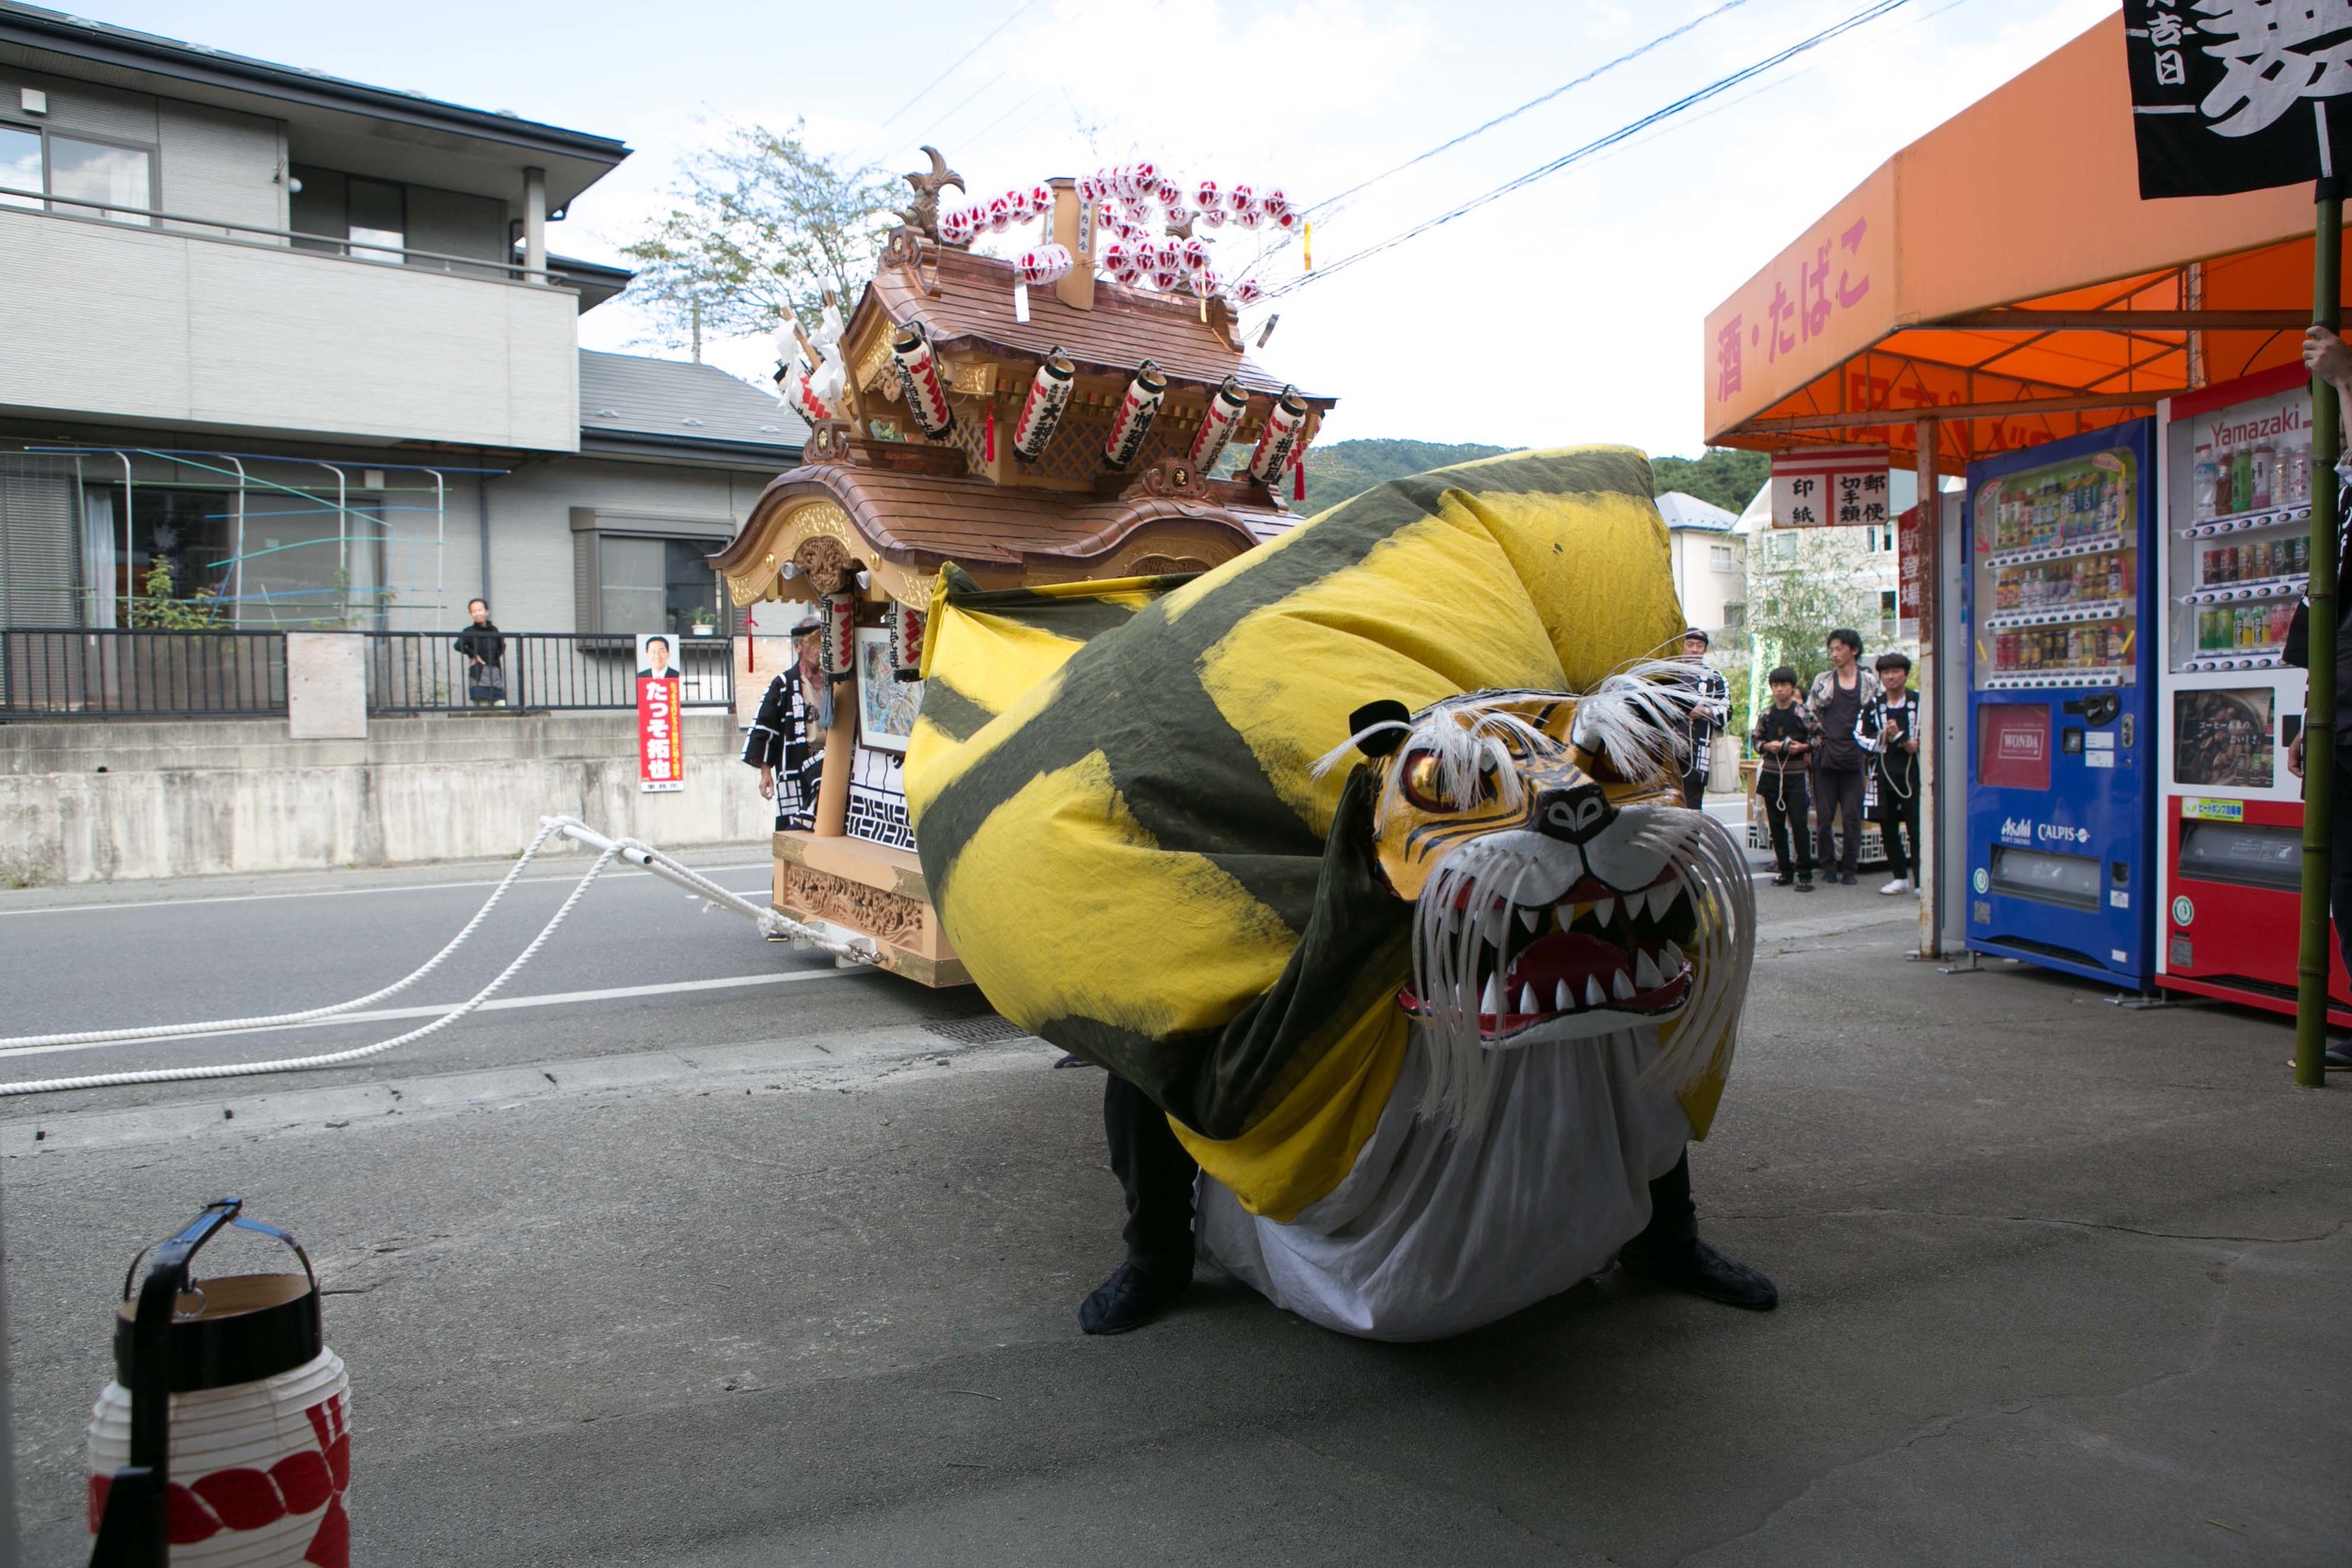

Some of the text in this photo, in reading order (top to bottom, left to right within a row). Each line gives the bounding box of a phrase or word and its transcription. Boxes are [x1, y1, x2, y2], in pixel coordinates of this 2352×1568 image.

[2146, 0, 2185, 86] 吉日
[1717, 215, 1870, 403] 酒・たばこ
[2210, 404, 2299, 448] Yamazaki
[1792, 478, 1815, 524] 印紙
[1839, 476, 1861, 522] 切手類
[1863, 473, 1885, 521] 郵便
[1899, 528, 1920, 607] 新登場
[2004, 734, 2039, 749] WONDA
[2000, 816, 2032, 838] Asahi
[2038, 823, 2075, 842] CALPIS
